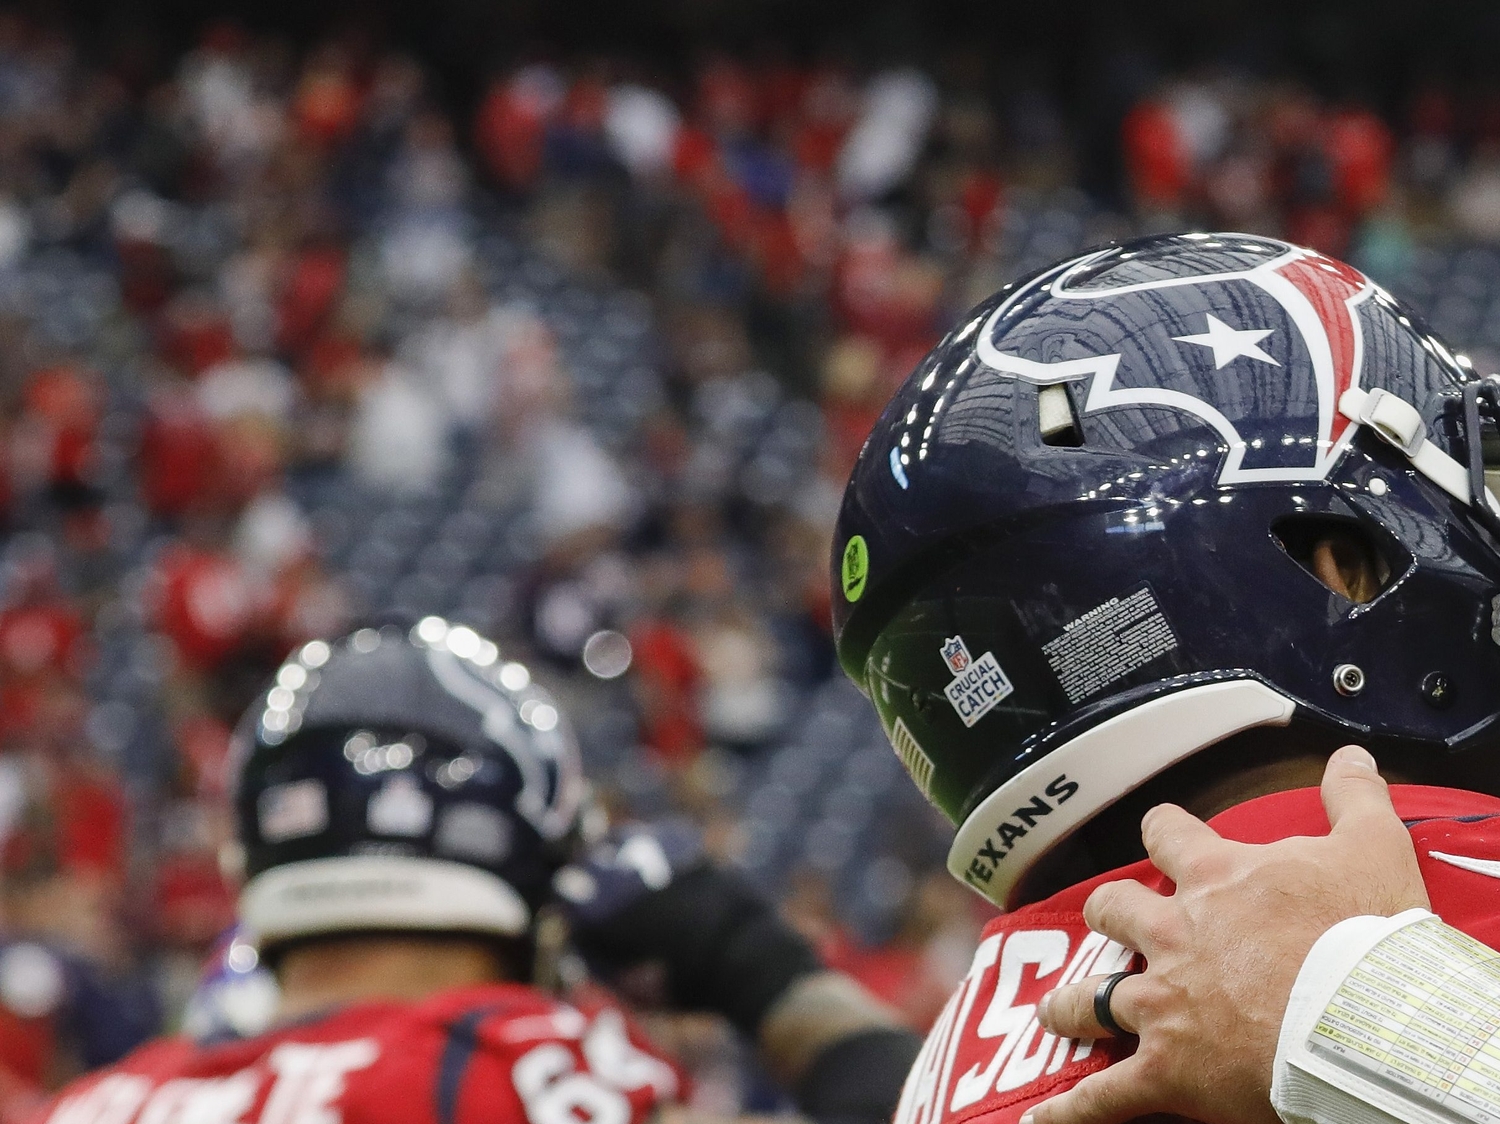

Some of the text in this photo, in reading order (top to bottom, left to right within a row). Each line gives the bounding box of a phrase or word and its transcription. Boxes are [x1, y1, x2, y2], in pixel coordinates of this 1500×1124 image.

[1062, 597, 1119, 632] WARNING
[949, 660, 995, 701] CRUCIAL
[958, 671, 1006, 717] CATCH
